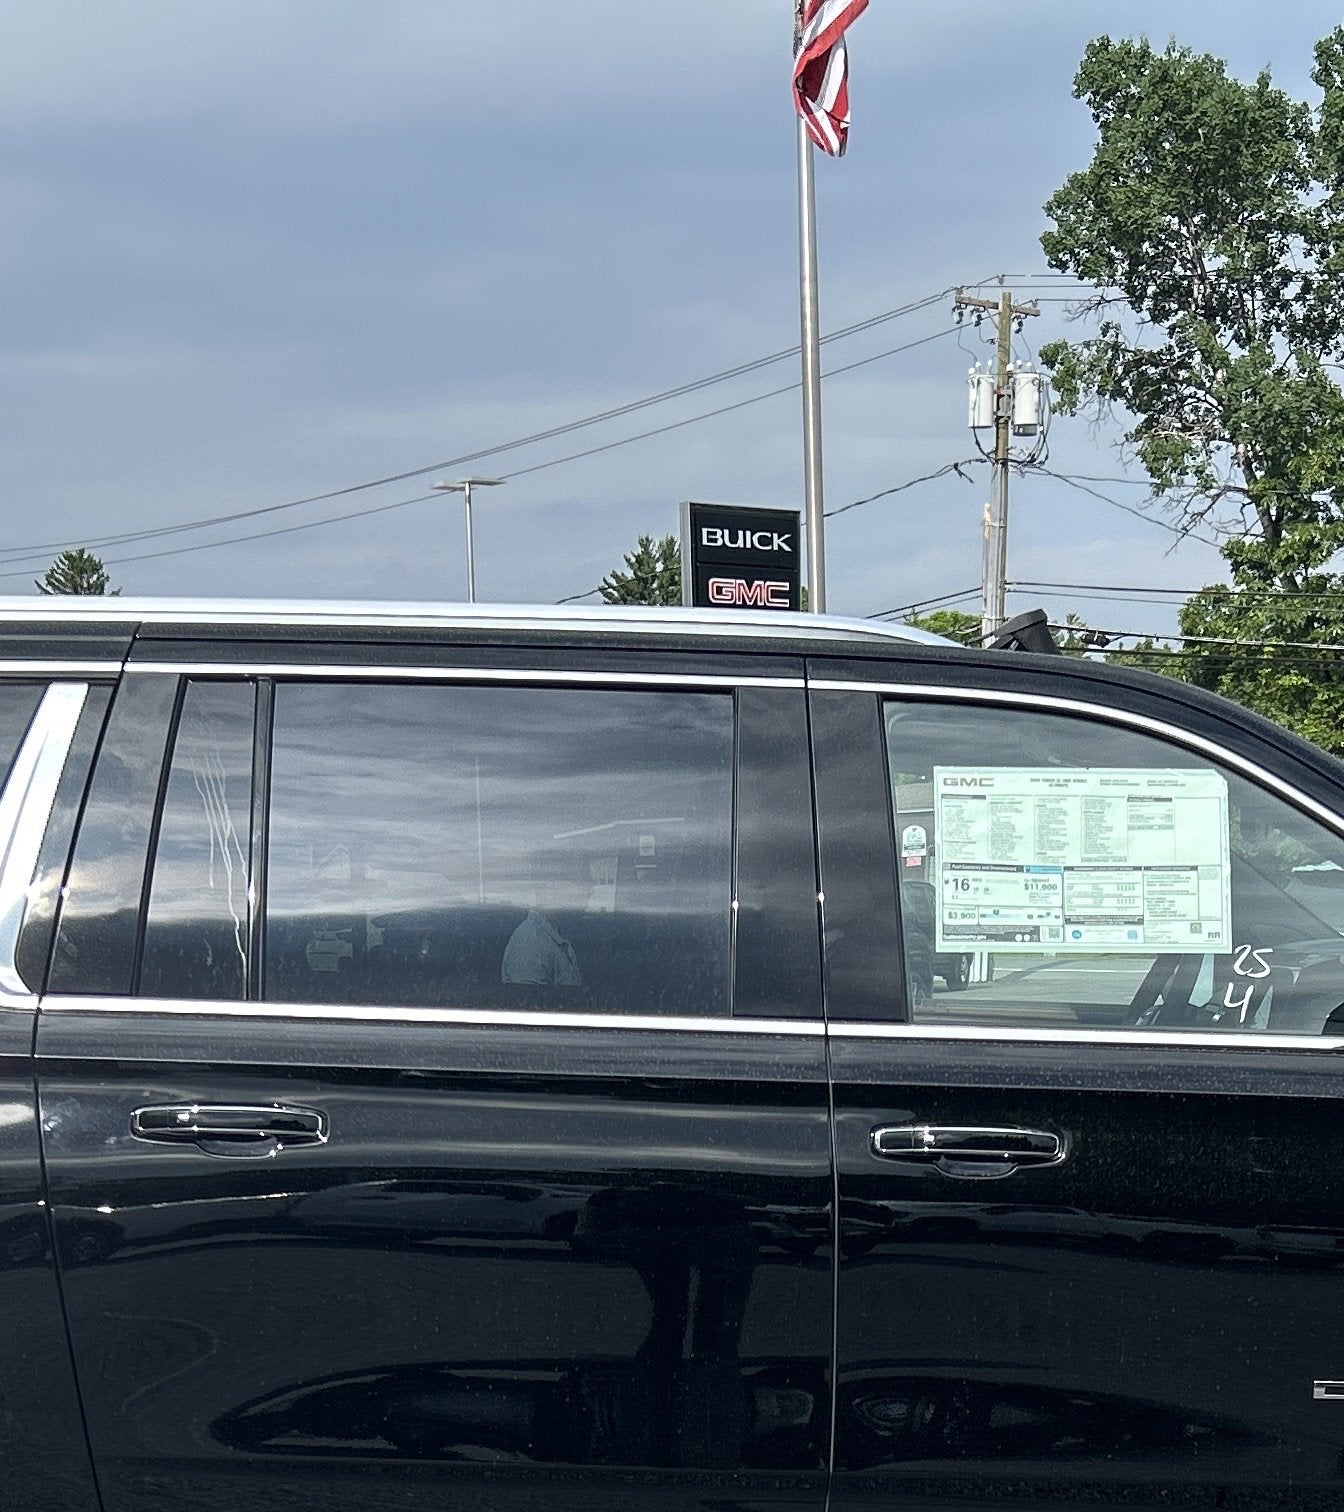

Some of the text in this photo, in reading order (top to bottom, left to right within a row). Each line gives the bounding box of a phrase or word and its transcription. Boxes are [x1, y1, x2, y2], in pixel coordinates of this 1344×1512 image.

[701, 527, 793, 552] BUICK
[708, 577, 790, 608] GMC
[943, 777, 995, 787] GMC
[952, 877, 970, 892] 16
[1233, 944, 1274, 978] 25
